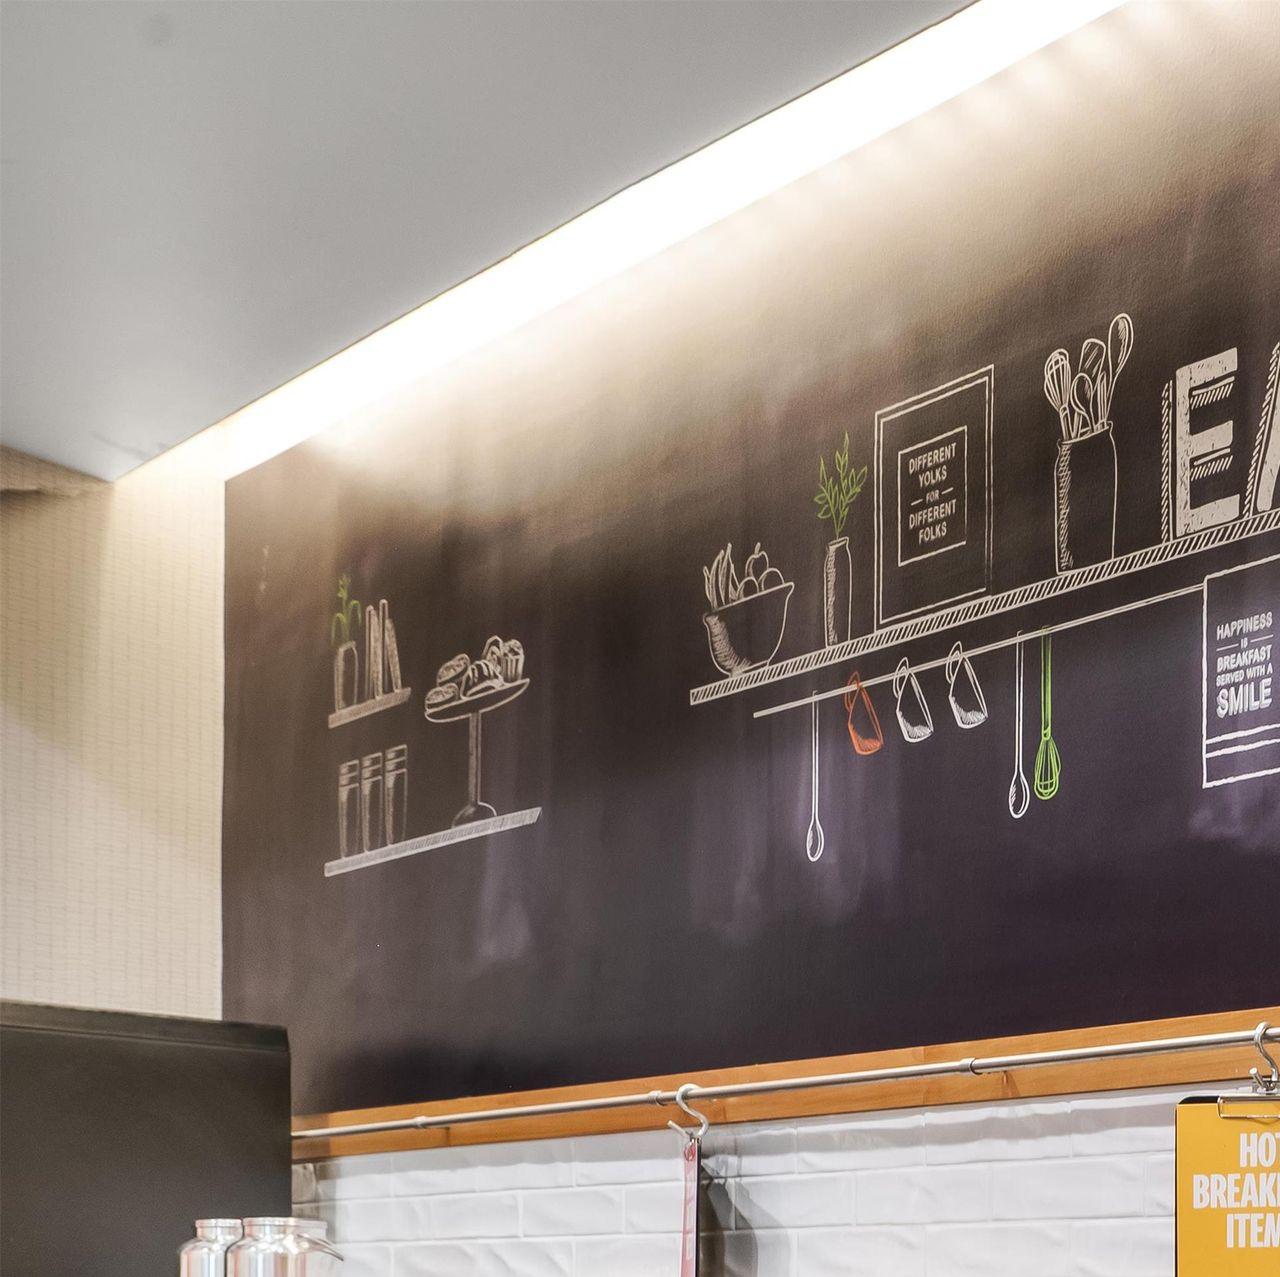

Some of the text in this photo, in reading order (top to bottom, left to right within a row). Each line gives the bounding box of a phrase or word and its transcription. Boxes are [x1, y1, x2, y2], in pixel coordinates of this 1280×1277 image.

[909, 442, 957, 475] DIFFERENT
[918, 465, 947, 488] YOLKS
[926, 489, 940, 504] FOR
[909, 499, 957, 530] DIFFERENT
[918, 522, 947, 544] FOLKS
[1216, 611, 1273, 641] HAPPINESS
[1240, 637, 1248, 649] IS
[1216, 644, 1272, 673] BREAKFAST
[1216, 662, 1273, 687] SERVED WITH A
[1216, 677, 1272, 718] SMILE
